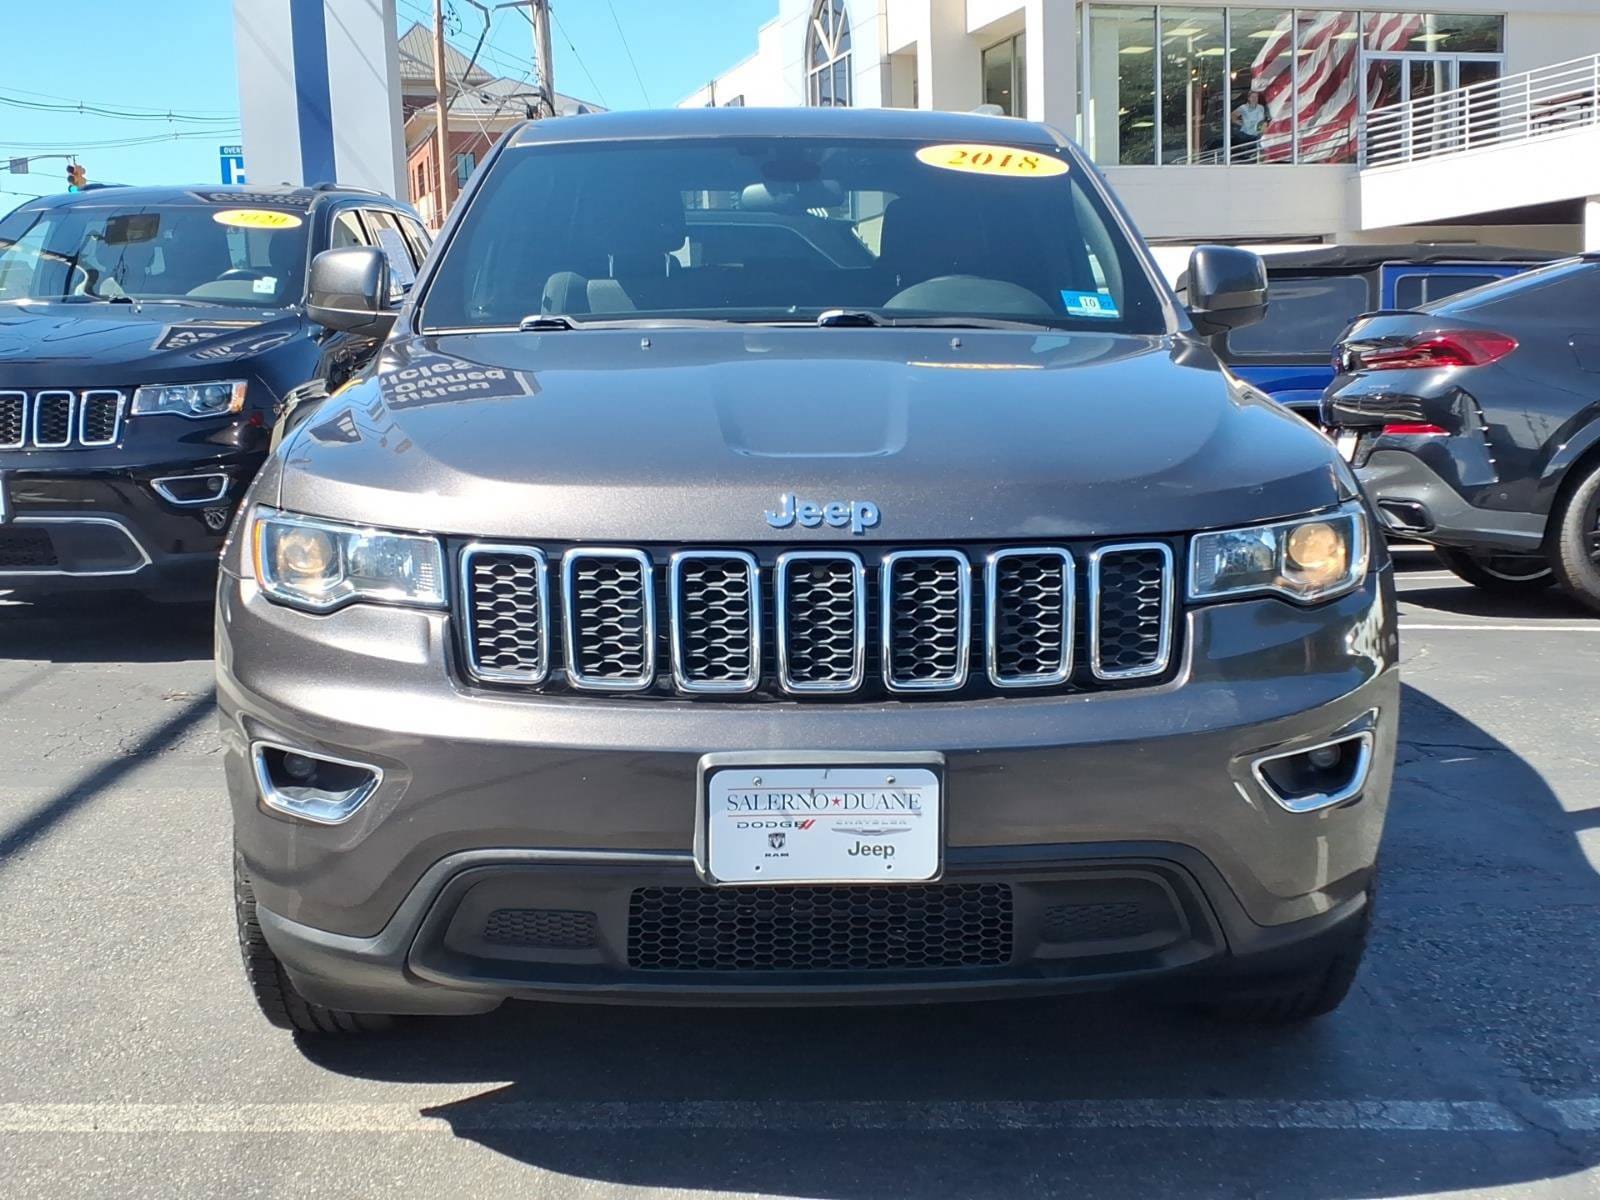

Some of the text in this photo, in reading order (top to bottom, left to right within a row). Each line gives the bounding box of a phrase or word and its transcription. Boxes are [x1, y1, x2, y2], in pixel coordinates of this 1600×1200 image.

[948, 151, 1039, 169] 2018
[1083, 298, 1096, 307] 10
[764, 492, 880, 534] Jeep
[727, 792, 921, 811] SALERNO DUANE
[737, 821, 804, 829] DODGE
[848, 841, 895, 858] Jeep
